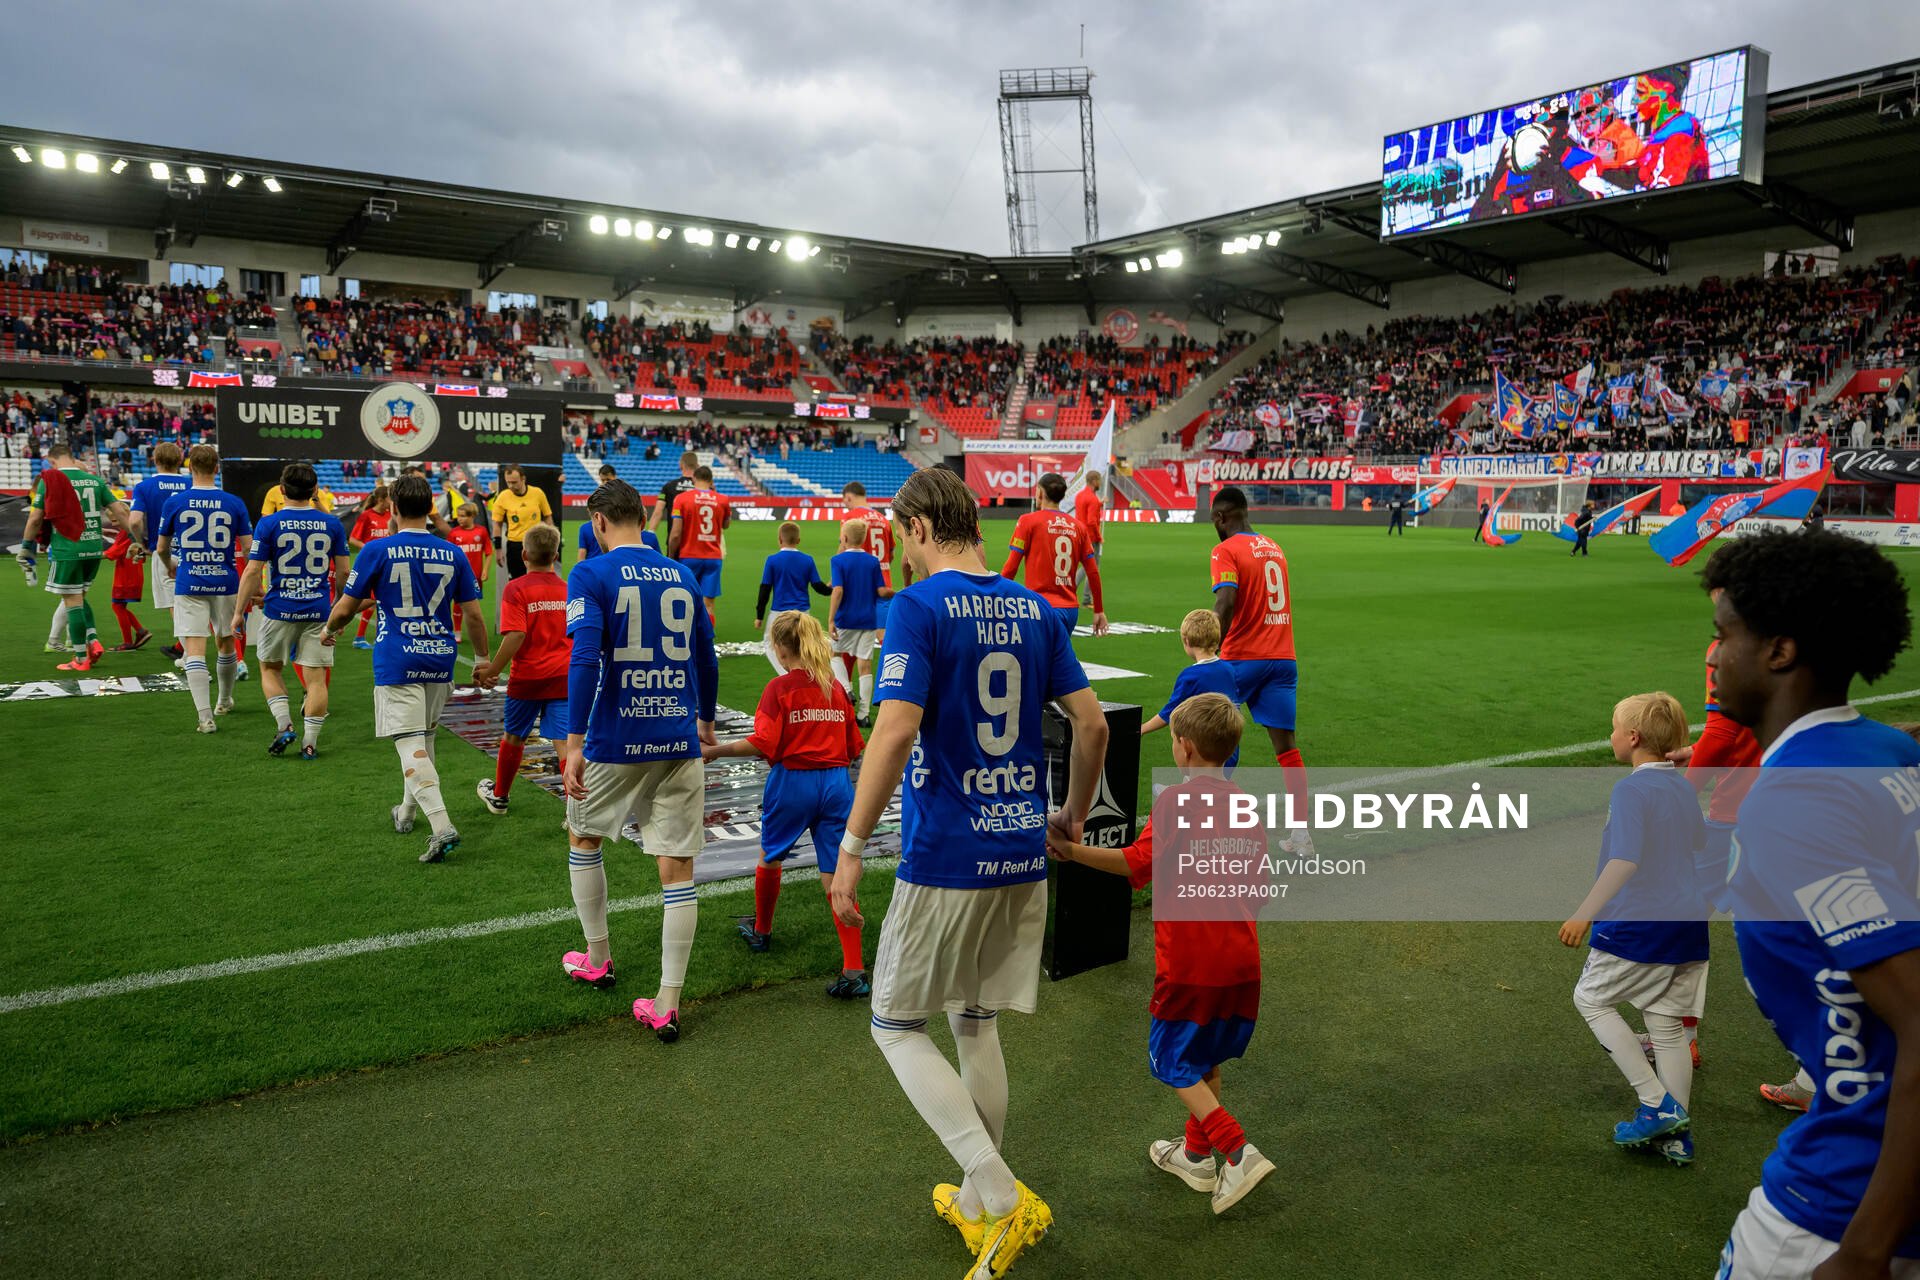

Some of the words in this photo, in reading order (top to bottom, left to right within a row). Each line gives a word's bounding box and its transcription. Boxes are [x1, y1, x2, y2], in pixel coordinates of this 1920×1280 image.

[237, 402, 341, 426] UNIBET
[392, 417, 410, 430] HIF
[457, 411, 546, 433] UNIBET
[1214, 459, 1259, 480] SÖDRA
[1310, 460, 1352, 480] 1985
[1832, 450, 1897, 473] Vila
[71, 479, 99, 487] ENBERG
[159, 481, 186, 490] ÖHMAN
[189, 499, 221, 509] EKMAN
[179, 510, 232, 549] 26
[280, 520, 327, 531] PERSSON
[699, 505, 714, 535] 3
[276, 532, 331, 575] 28
[388, 547, 454, 562] MARTIATU
[870, 528, 885, 563] 5
[185, 550, 225, 563] renta
[1054, 535, 1073, 577] 8
[280, 576, 322, 589] renta
[621, 565, 682, 583] OLSSON
[389, 562, 455, 618] 17
[1264, 560, 1286, 612] 9
[945, 595, 1042, 621] HARBOSEN
[400, 620, 449, 636] renta
[613, 585, 695, 662] 19
[977, 621, 1022, 646] HAGA
[402, 645, 454, 655] WELLNESS
[412, 639, 447, 648] NORDIC
[406, 671, 417, 679] TM
[418, 671, 436, 679] Rent
[437, 671, 448, 679] AB
[621, 666, 686, 689] renta
[631, 696, 678, 706] NORDIC
[977, 651, 1022, 757] 9
[619, 706, 688, 718] WELLNESS
[624, 744, 642, 755] TM
[644, 743, 671, 754] Rent
[672, 741, 688, 752] AB
[963, 761, 1036, 795] renta
[980, 800, 1034, 818] NORDIC
[969, 813, 1045, 833] WELLNESS
[1083, 823, 1128, 848] ELECT
[976, 861, 998, 876] TM
[1001, 859, 1030, 874] Rent
[1031, 857, 1045, 871] AB
